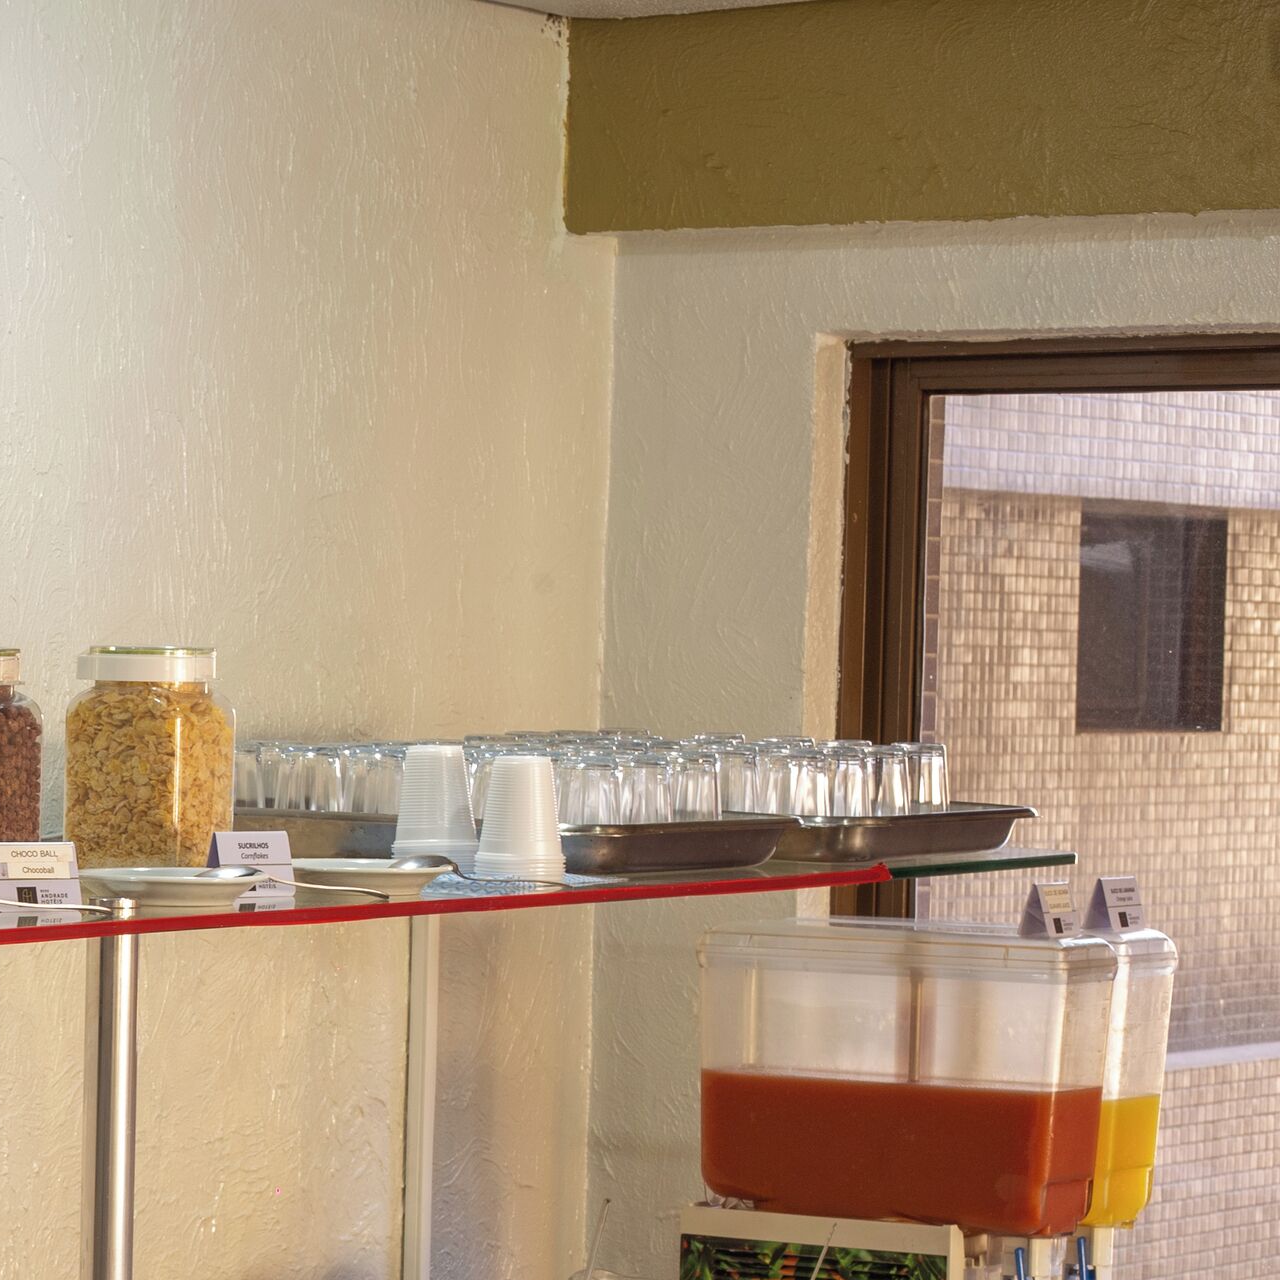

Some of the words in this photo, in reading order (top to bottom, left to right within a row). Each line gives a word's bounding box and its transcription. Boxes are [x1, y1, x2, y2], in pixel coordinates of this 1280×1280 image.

[11, 850, 38, 858] CHOCO
[41, 850, 58, 858] BALL
[241, 852, 269, 861] Cornflakes
[22, 866, 55, 874] Chocoball
